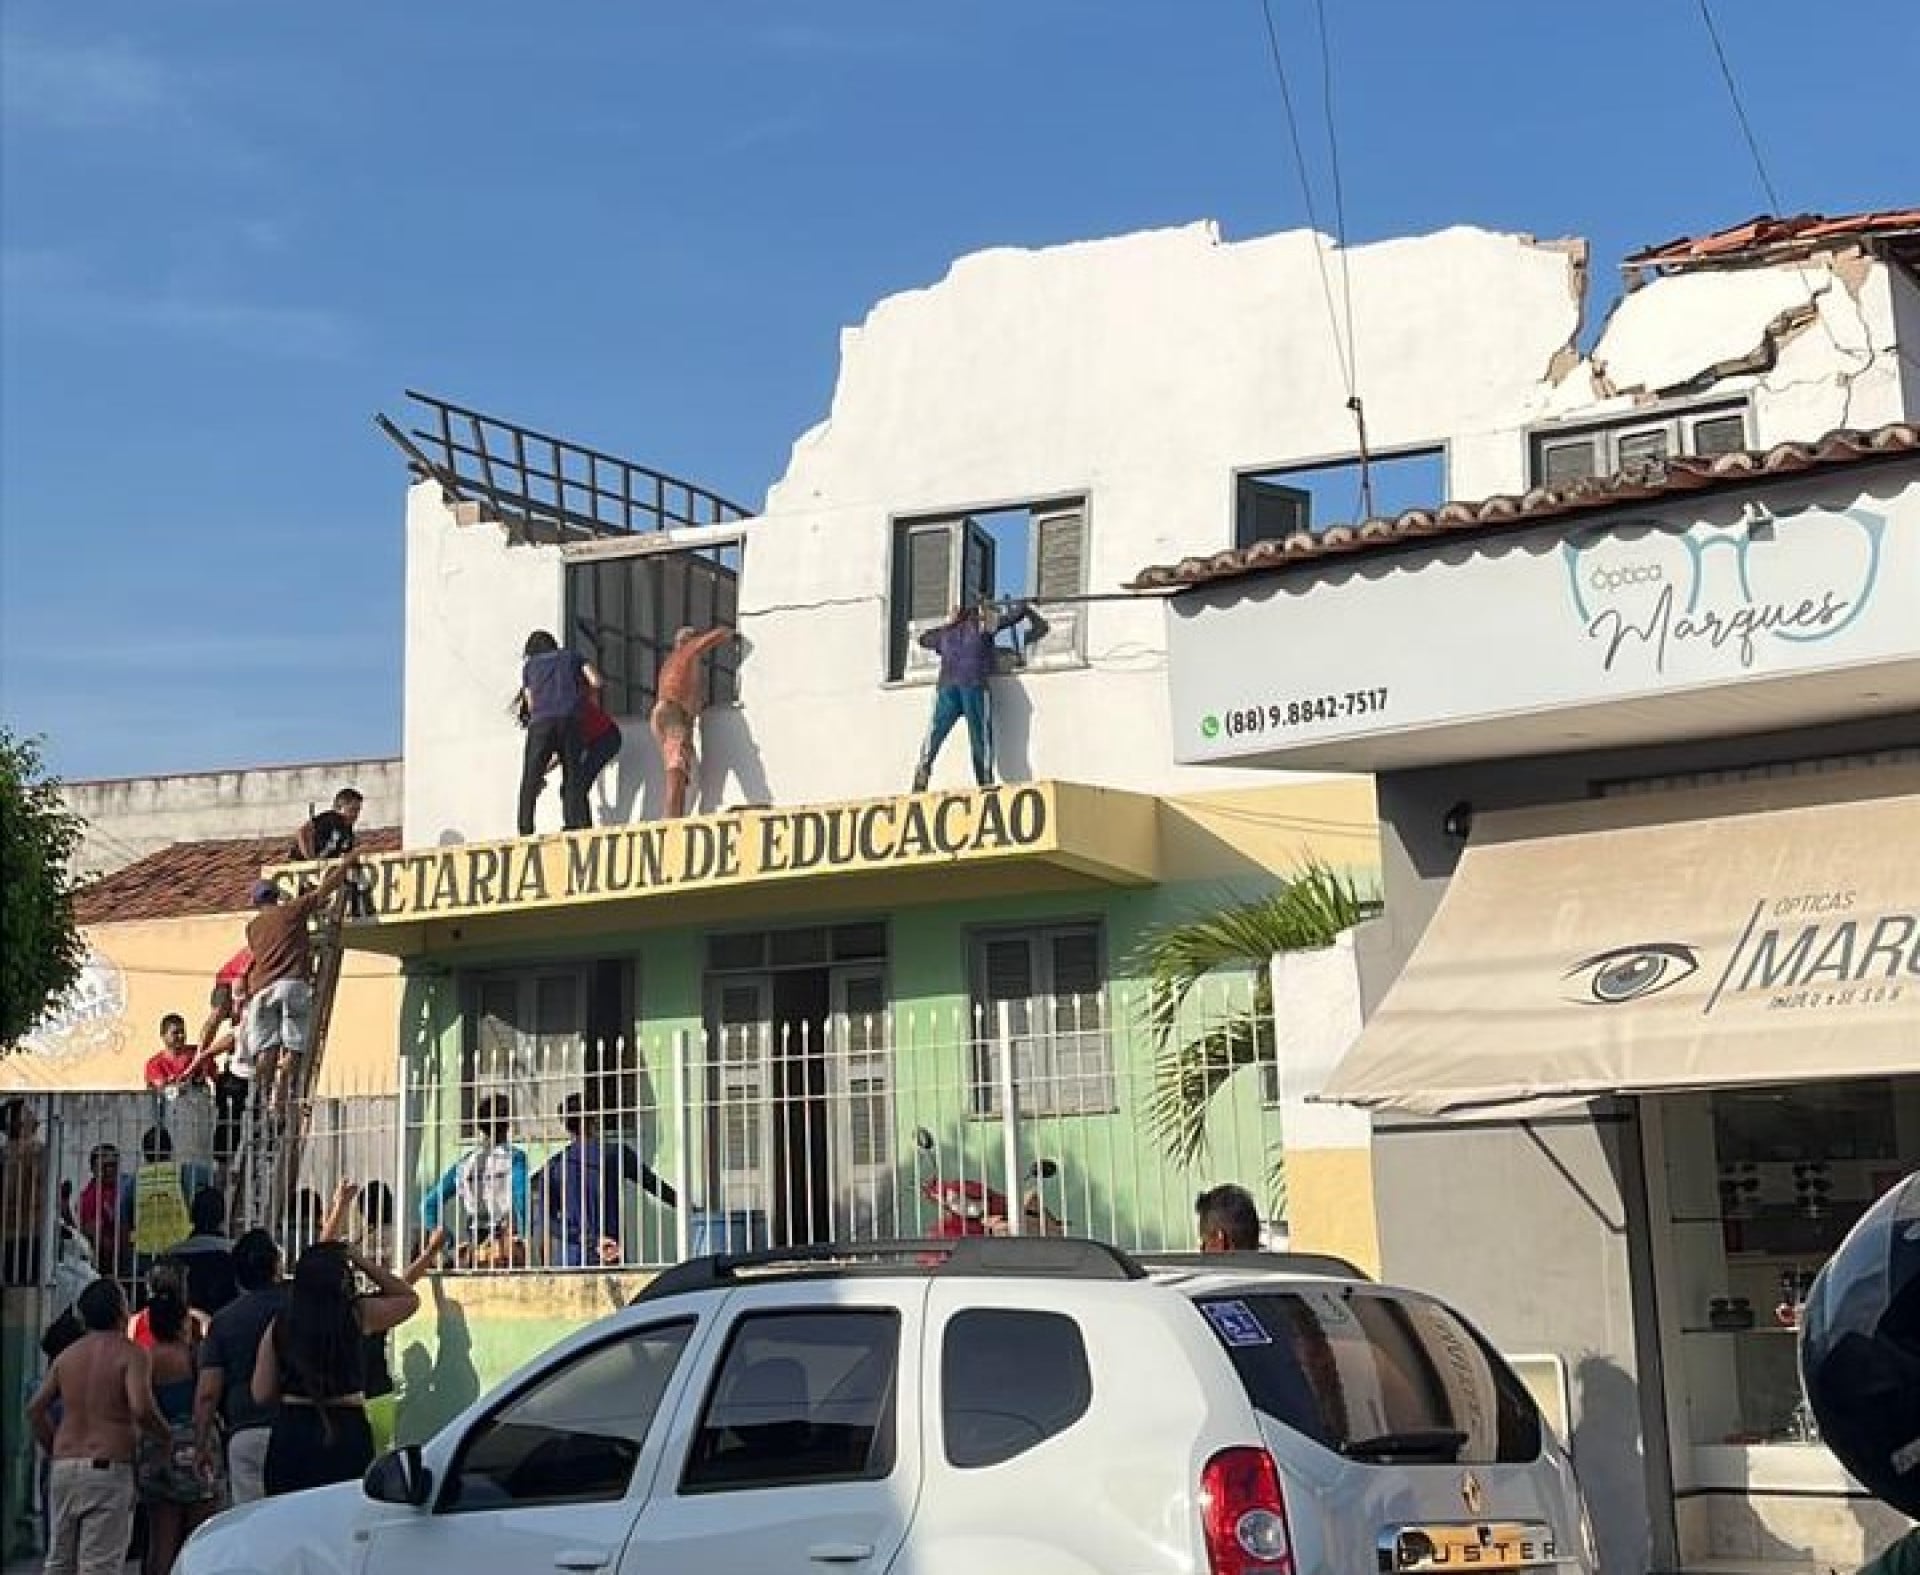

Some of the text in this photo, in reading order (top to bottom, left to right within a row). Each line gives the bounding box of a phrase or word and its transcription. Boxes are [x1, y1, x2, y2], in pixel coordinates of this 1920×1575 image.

[1588, 583, 1848, 674] Marques
[1225, 687, 1388, 738] (88) 9.8842-7517
[271, 785, 1046, 917] SERETARIA MUN. DE EDUCAÇÃO
